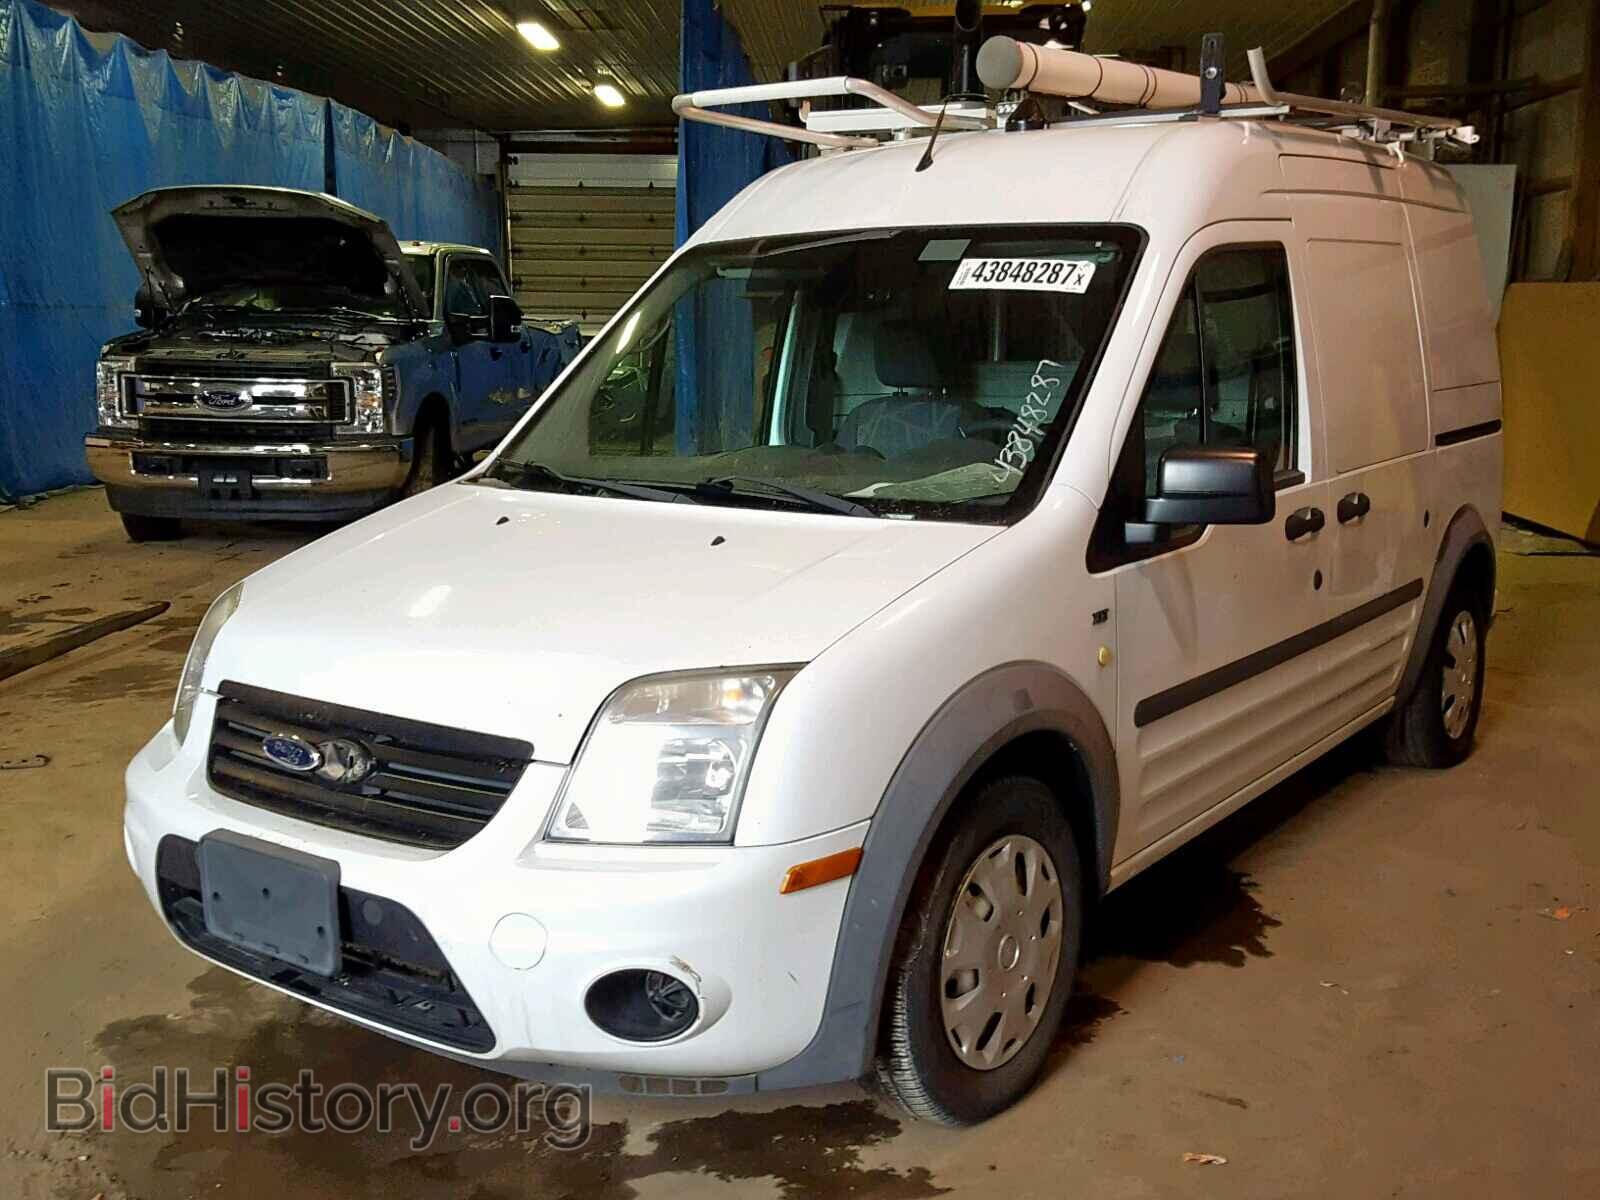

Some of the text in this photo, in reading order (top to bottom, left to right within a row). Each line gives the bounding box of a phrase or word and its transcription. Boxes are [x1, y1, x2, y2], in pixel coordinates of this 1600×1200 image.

[971, 261, 1078, 285] 43848287
[208, 394, 236, 406] Ford
[992, 359, 1064, 483] 43848287
